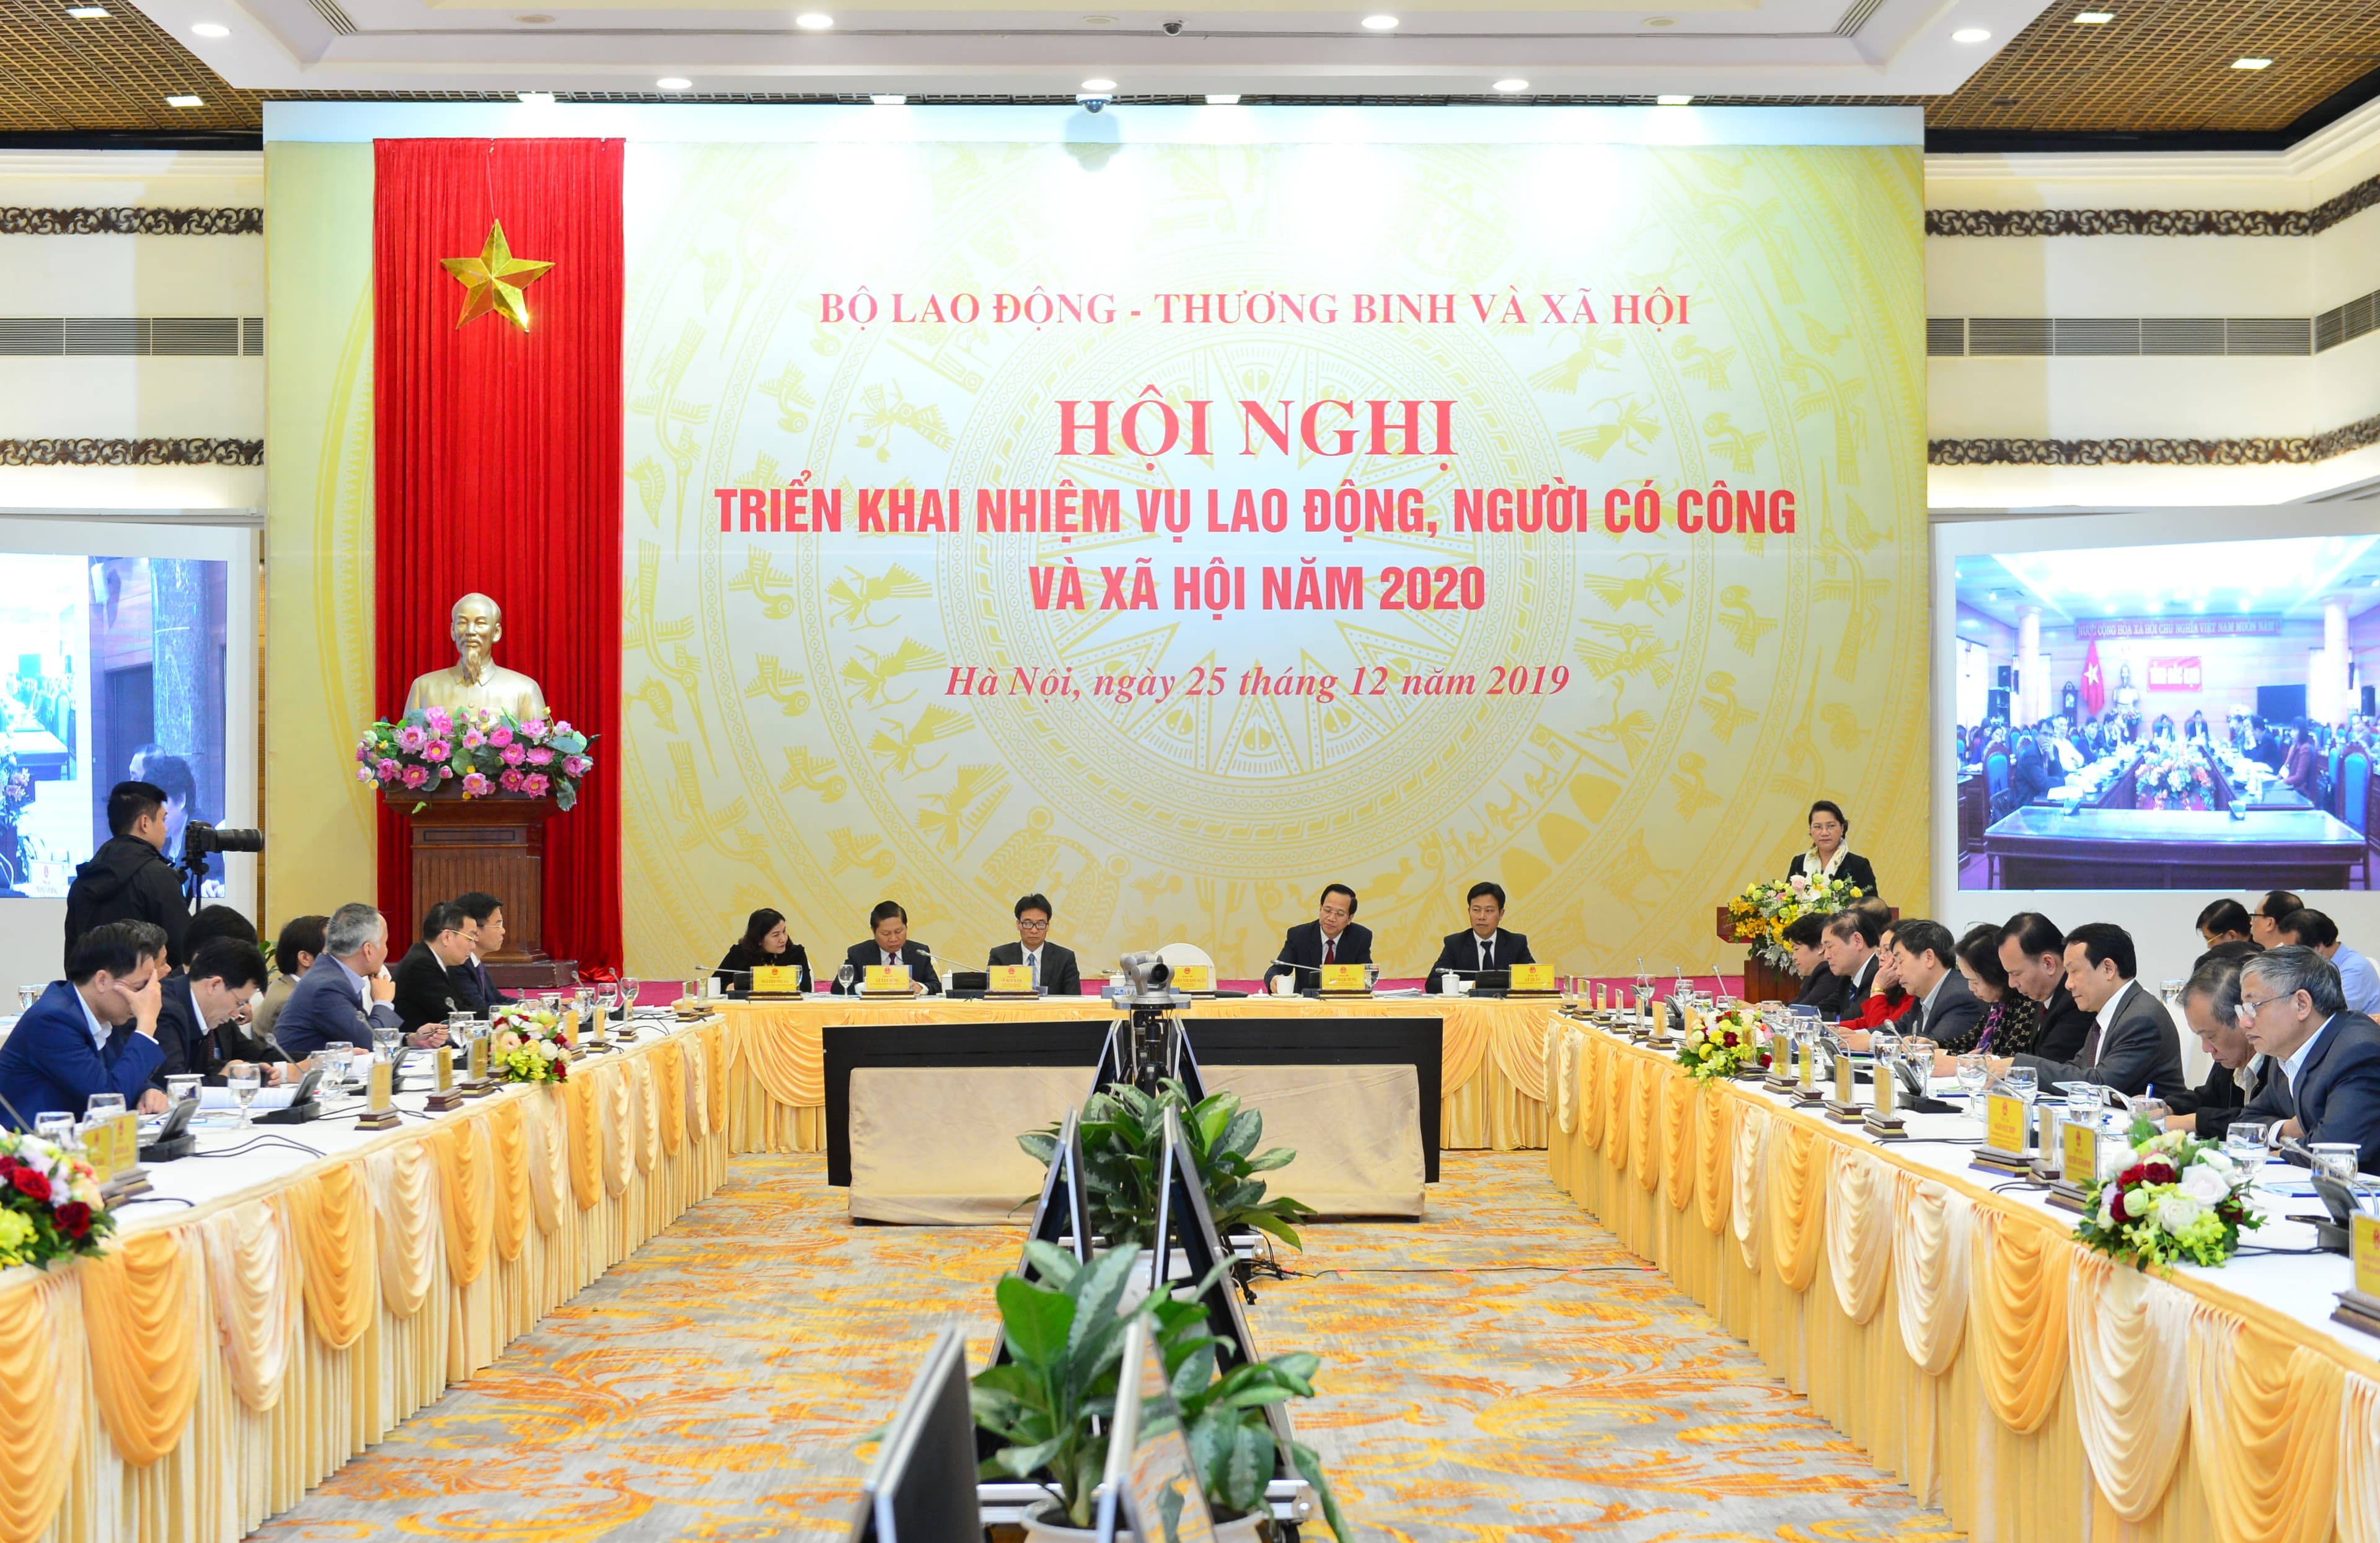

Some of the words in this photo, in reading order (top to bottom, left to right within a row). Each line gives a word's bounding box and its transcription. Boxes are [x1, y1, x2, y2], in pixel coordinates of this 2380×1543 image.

[819, 285, 878, 331] BỘ
[891, 293, 980, 323] LAO
[992, 285, 1116, 331] ĐỘNG
[1154, 289, 1339, 323] THƯƠNG
[1354, 294, 1456, 323] BINH
[1470, 285, 1528, 324] VÀ
[1541, 288, 1598, 324] XÃ
[1613, 286, 1690, 332] HỘI
[1056, 384, 1213, 472] HỘI
[1240, 400, 1455, 472] NGHỊ
[714, 469, 842, 533] TRIỂN
[858, 488, 960, 532] KHAI
[977, 479, 1121, 543] NHIỆM
[1136, 488, 1191, 543] VỤ
[1208, 488, 1288, 533] LAO
[1303, 479, 1437, 543] ĐỘNG,
[1454, 477, 1588, 534] NGƯỜI
[1605, 479, 1661, 534] CÓ
[1677, 480, 1796, 534] CÔNG
[1029, 556, 1086, 610] VÀ
[1100, 558, 1158, 610] XÃ
[1175, 557, 1245, 620] HỘI
[1263, 557, 1364, 610] NĂM
[1380, 566, 1485, 610] 2020
[946, 666, 998, 697] Hà
[1008, 666, 1082, 704] Nội,
[1094, 667, 1176, 704] ngày
[1186, 666, 1228, 697] 25
[1239, 666, 1339, 704] tháng
[1350, 666, 1388, 696] 12
[1401, 669, 1476, 697] năm
[1486, 666, 1571, 695] 2019
